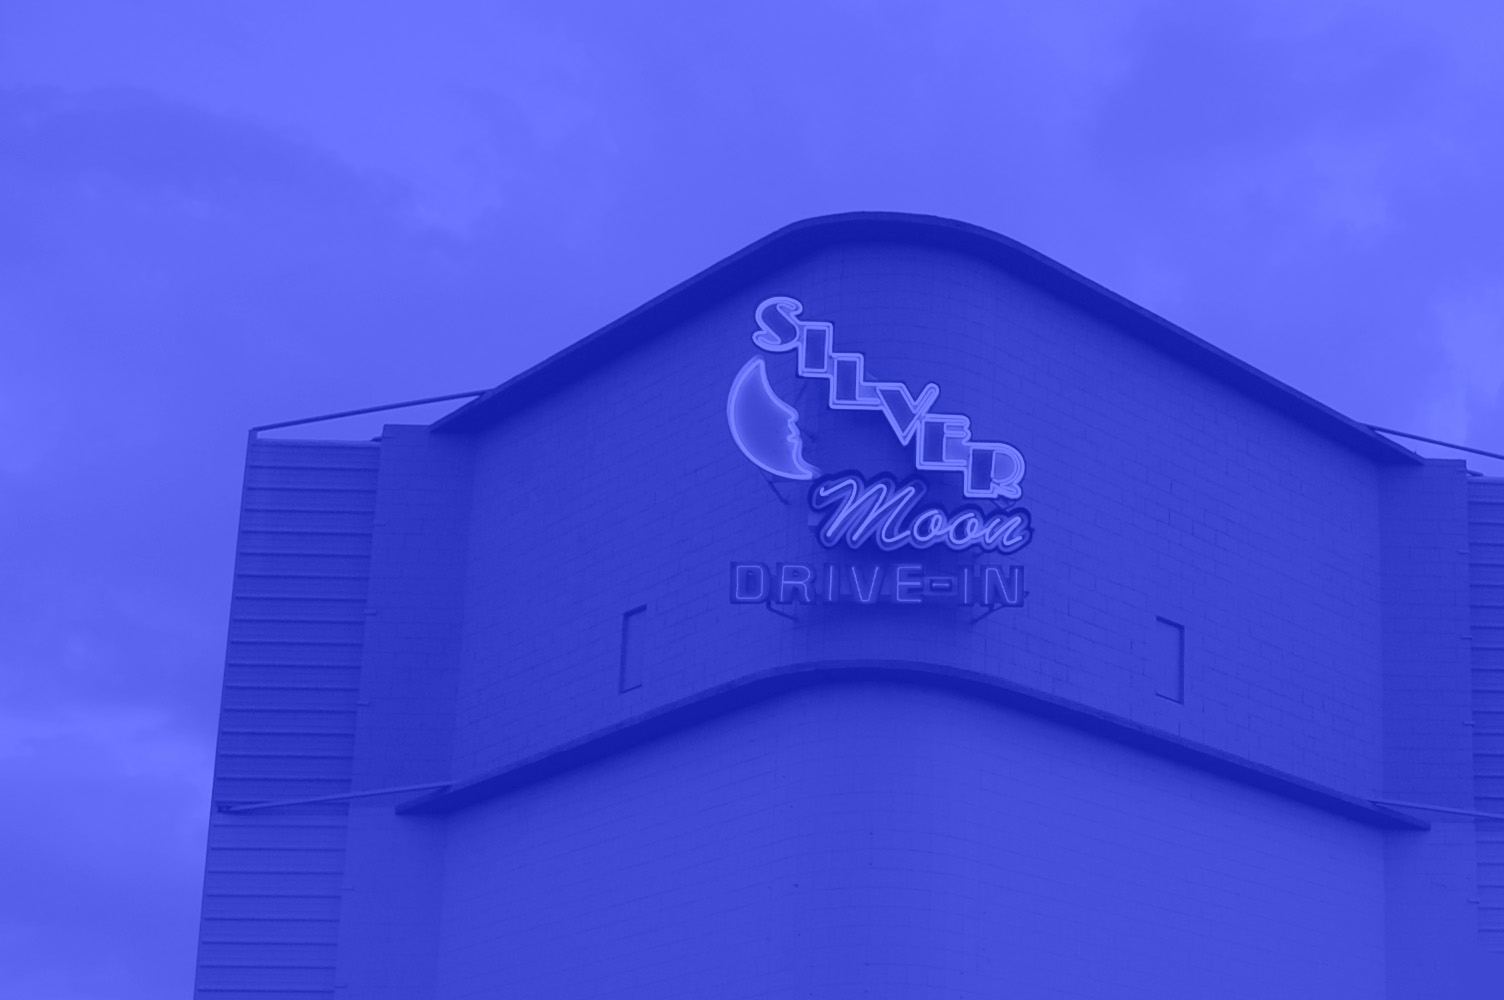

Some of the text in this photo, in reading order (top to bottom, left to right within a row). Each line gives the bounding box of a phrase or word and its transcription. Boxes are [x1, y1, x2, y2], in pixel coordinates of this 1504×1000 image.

[752, 296, 1025, 499] SILVER
[812, 475, 1030, 551] Moon
[730, 561, 1025, 606] DRIVE-IN
